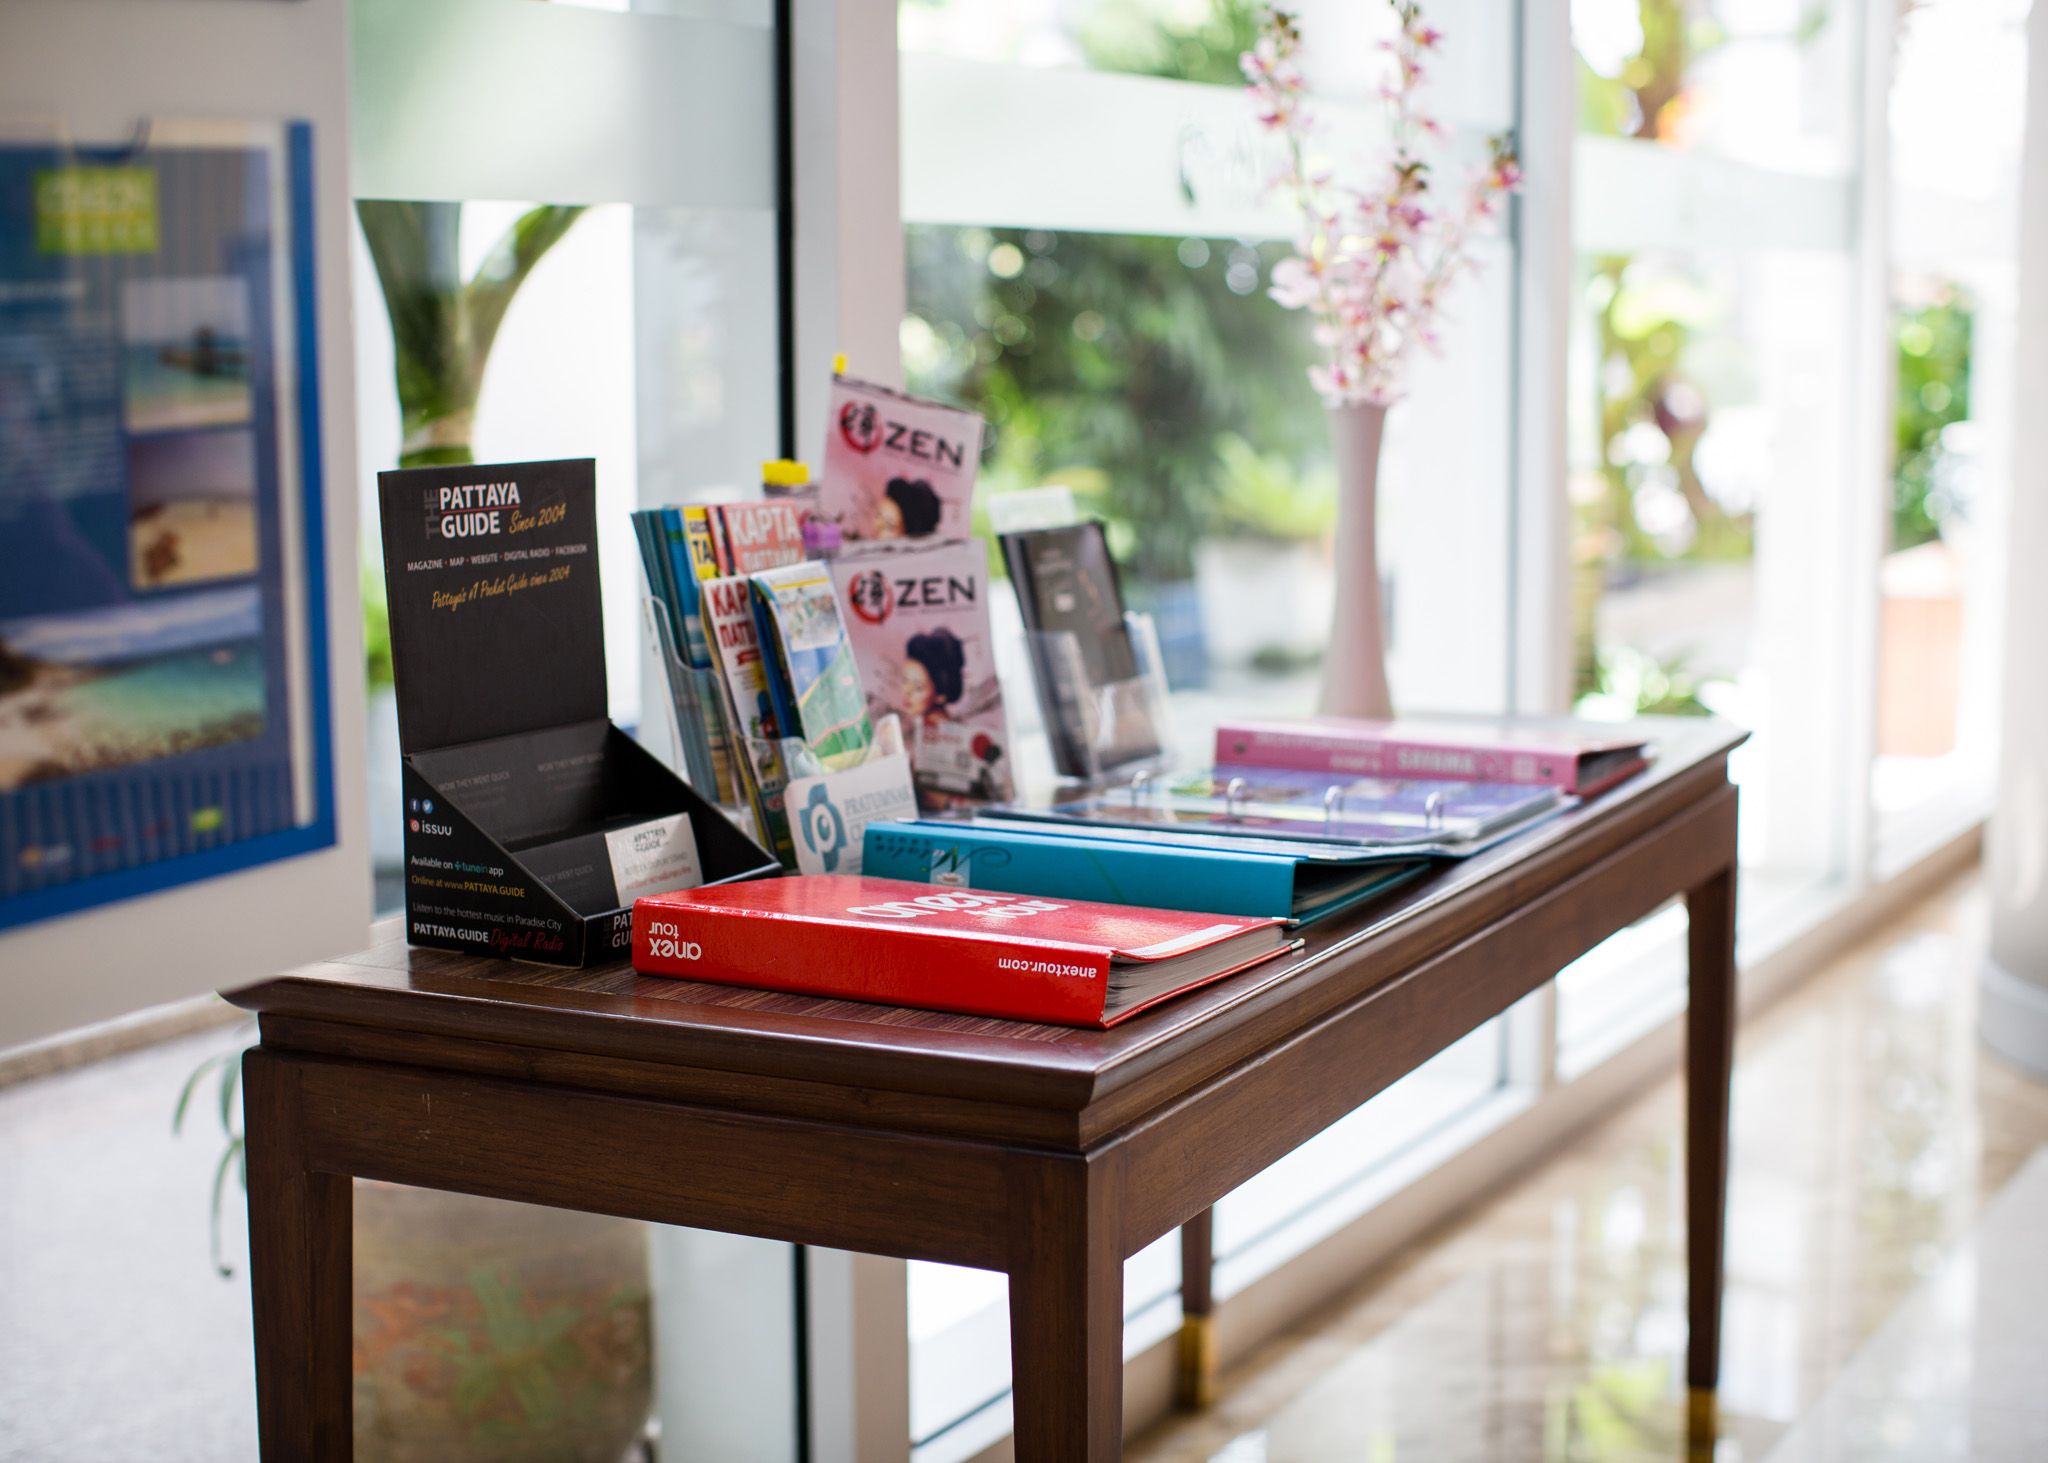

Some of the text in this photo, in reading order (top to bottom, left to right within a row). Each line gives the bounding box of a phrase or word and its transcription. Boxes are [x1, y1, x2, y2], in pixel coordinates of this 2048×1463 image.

[885, 420, 964, 468] ZEN
[440, 482, 521, 511] PATTAYA
[441, 511, 501, 539] GUIDE
[509, 503, 566, 534] Since 2004
[407, 544, 588, 572] MAGAZINE MAP WEBSITE DIGITAL RADIO FACEBOOK
[507, 573, 528, 597] Guide
[894, 574, 977, 608] ZEN
[422, 820, 452, 836] issuu
[411, 855, 442, 869] Available
[443, 861, 454, 869] on
[488, 867, 504, 878] app
[412, 875, 435, 888] Online
[435, 879, 443, 888] at
[413, 902, 562, 932] Listen to the hottest music in Paradise City
[846, 891, 1017, 918] anex
[414, 922, 563, 952] PATTAYA GUIDE Digital Radio
[649, 921, 679, 939] tour
[649, 937, 702, 960] anex
[998, 958, 1097, 978] anextour.com
